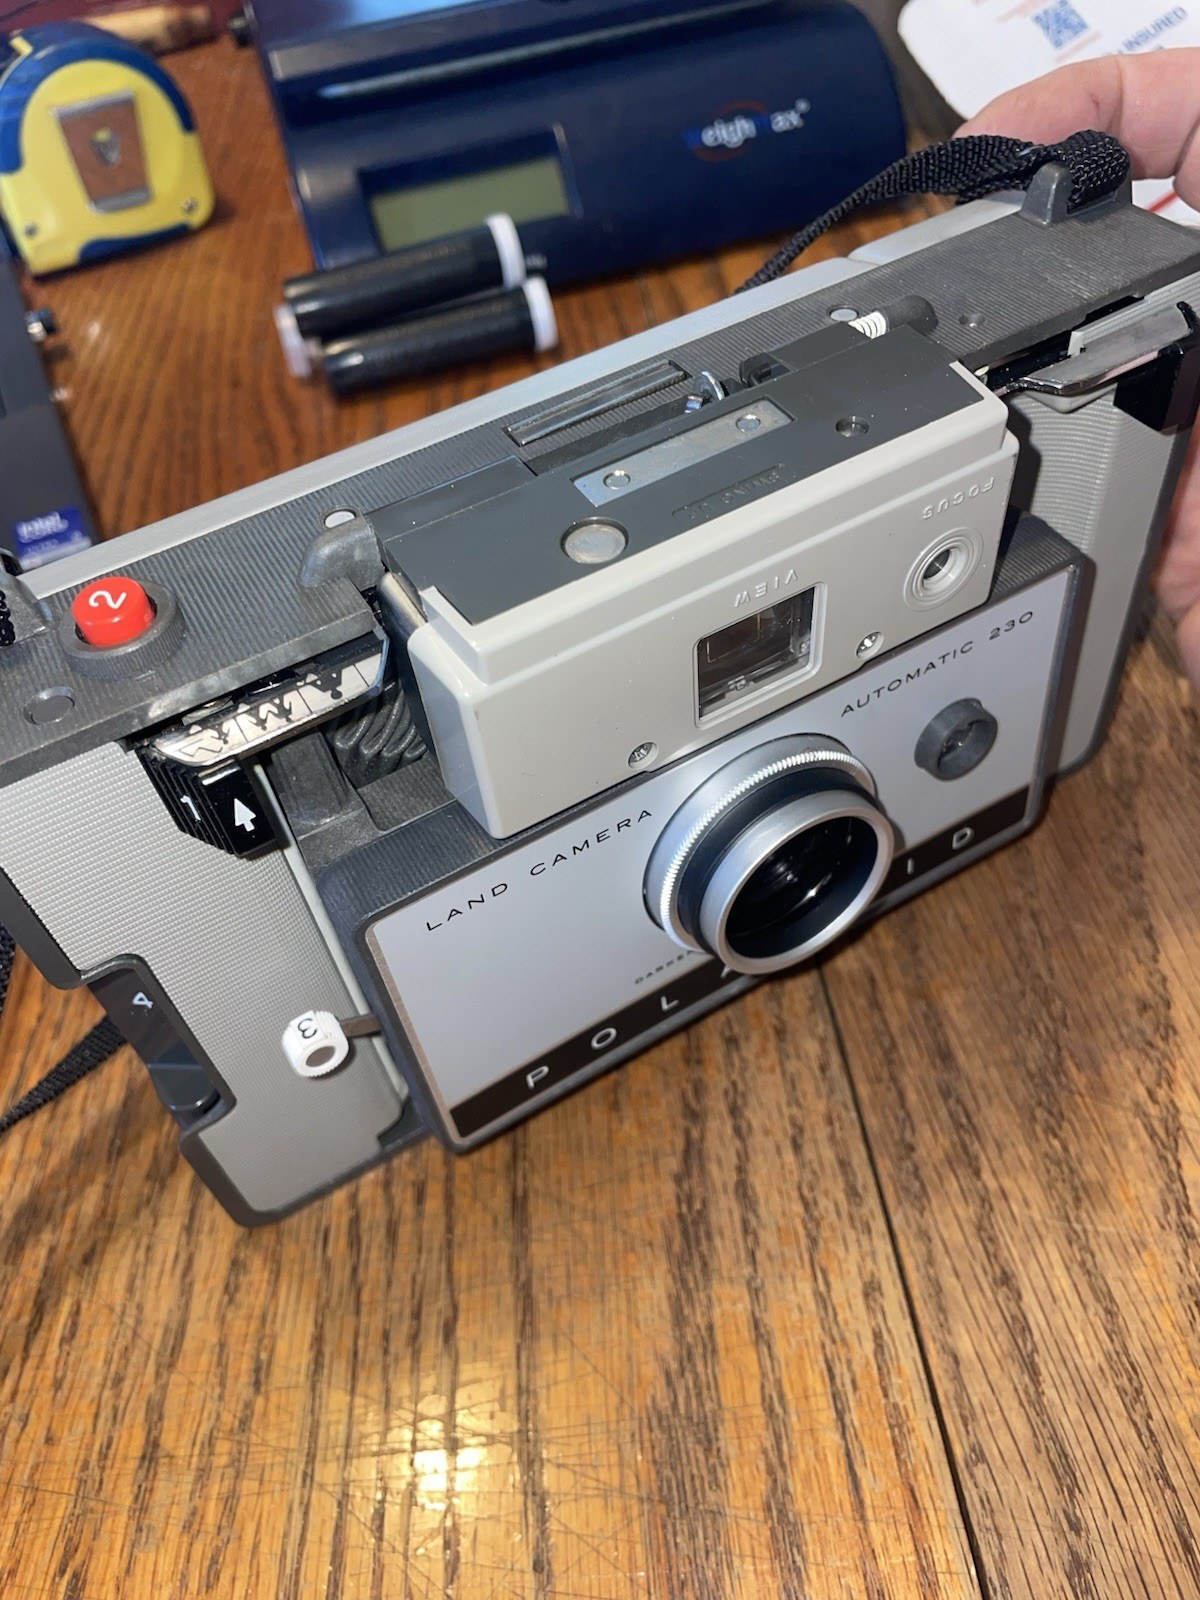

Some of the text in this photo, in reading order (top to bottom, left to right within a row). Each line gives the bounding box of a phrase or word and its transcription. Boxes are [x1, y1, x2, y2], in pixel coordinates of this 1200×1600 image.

[1122, 6, 1188, 51] INSURED
[921, 477, 994, 520] FOCUS
[89, 590, 127, 609] 2
[734, 569, 798, 607] VIEW
[841, 611, 1034, 718] AUTOMATIC 230
[180, 794, 201, 821] 1
[426, 809, 652, 931] LAND CAMERA
[526, 827, 974, 1088] POLID
[297, 1017, 317, 1040] 3
